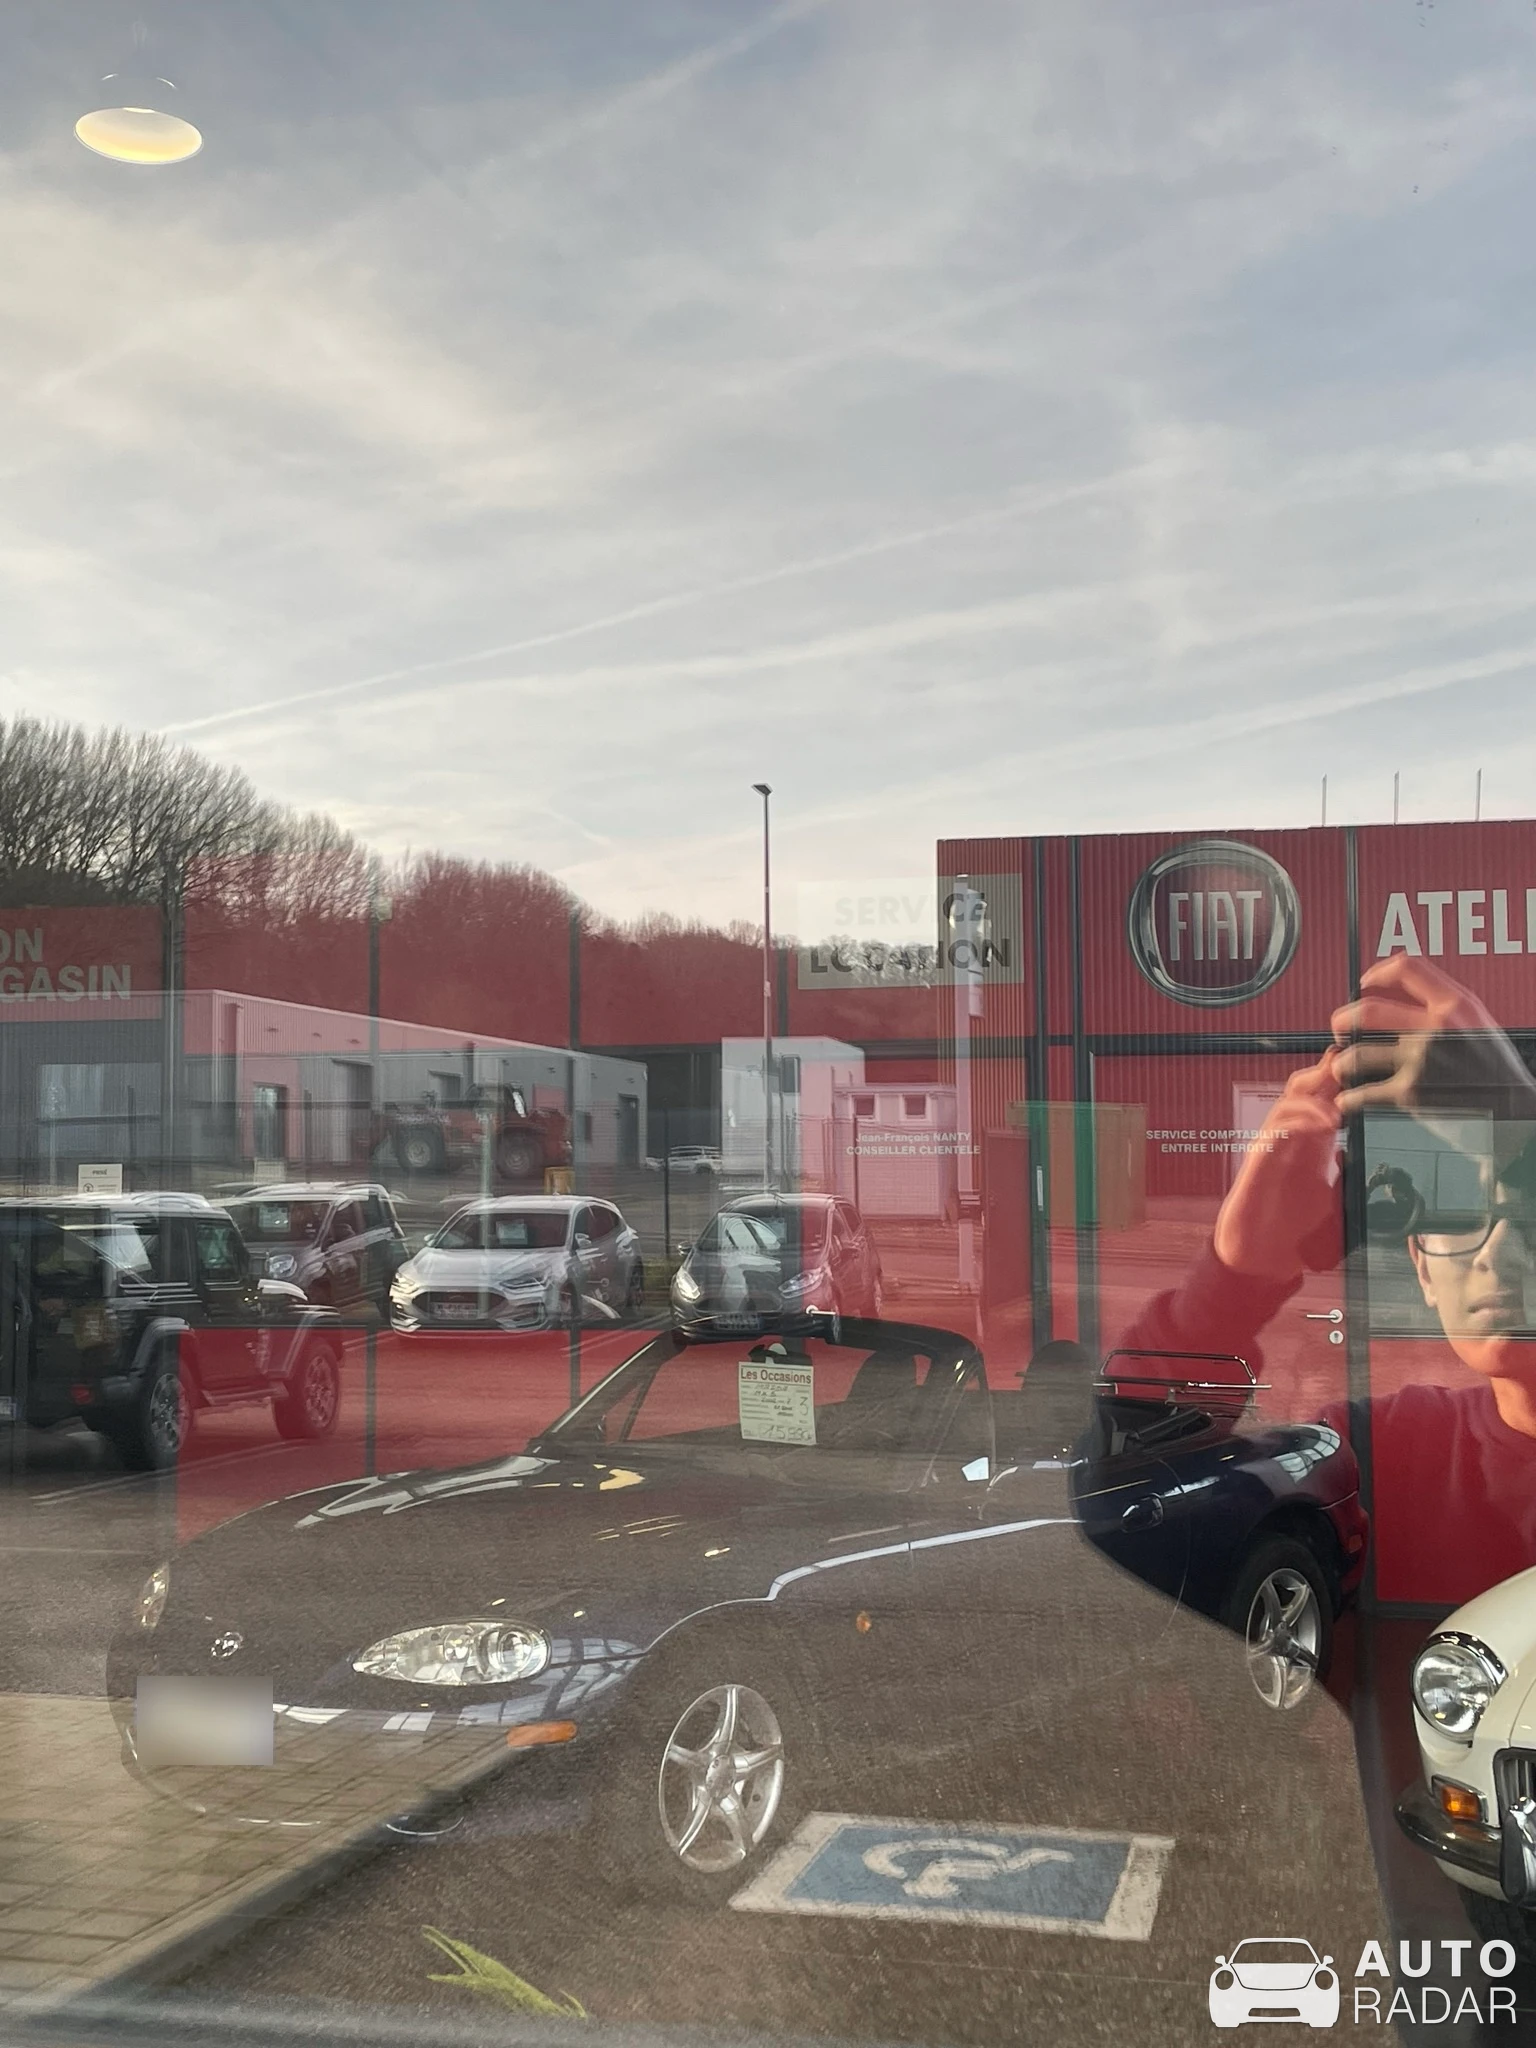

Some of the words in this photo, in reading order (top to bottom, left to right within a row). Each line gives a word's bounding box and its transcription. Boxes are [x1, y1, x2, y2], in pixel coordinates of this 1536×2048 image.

[1168, 890, 1262, 961] FIAT
[933, 1131, 972, 1143] NANTY
[1146, 1129, 1197, 1140] SERVICE
[1199, 1129, 1289, 1140] COMPTABILITE
[846, 1145, 916, 1155] CONSEILLER
[919, 1145, 981, 1155] CLIENTELE
[1161, 1143, 1208, 1153] ENTREE
[1211, 1143, 1274, 1153] INTERDITE
[740, 1368, 758, 1380] Les
[760, 1369, 812, 1384] Occasions
